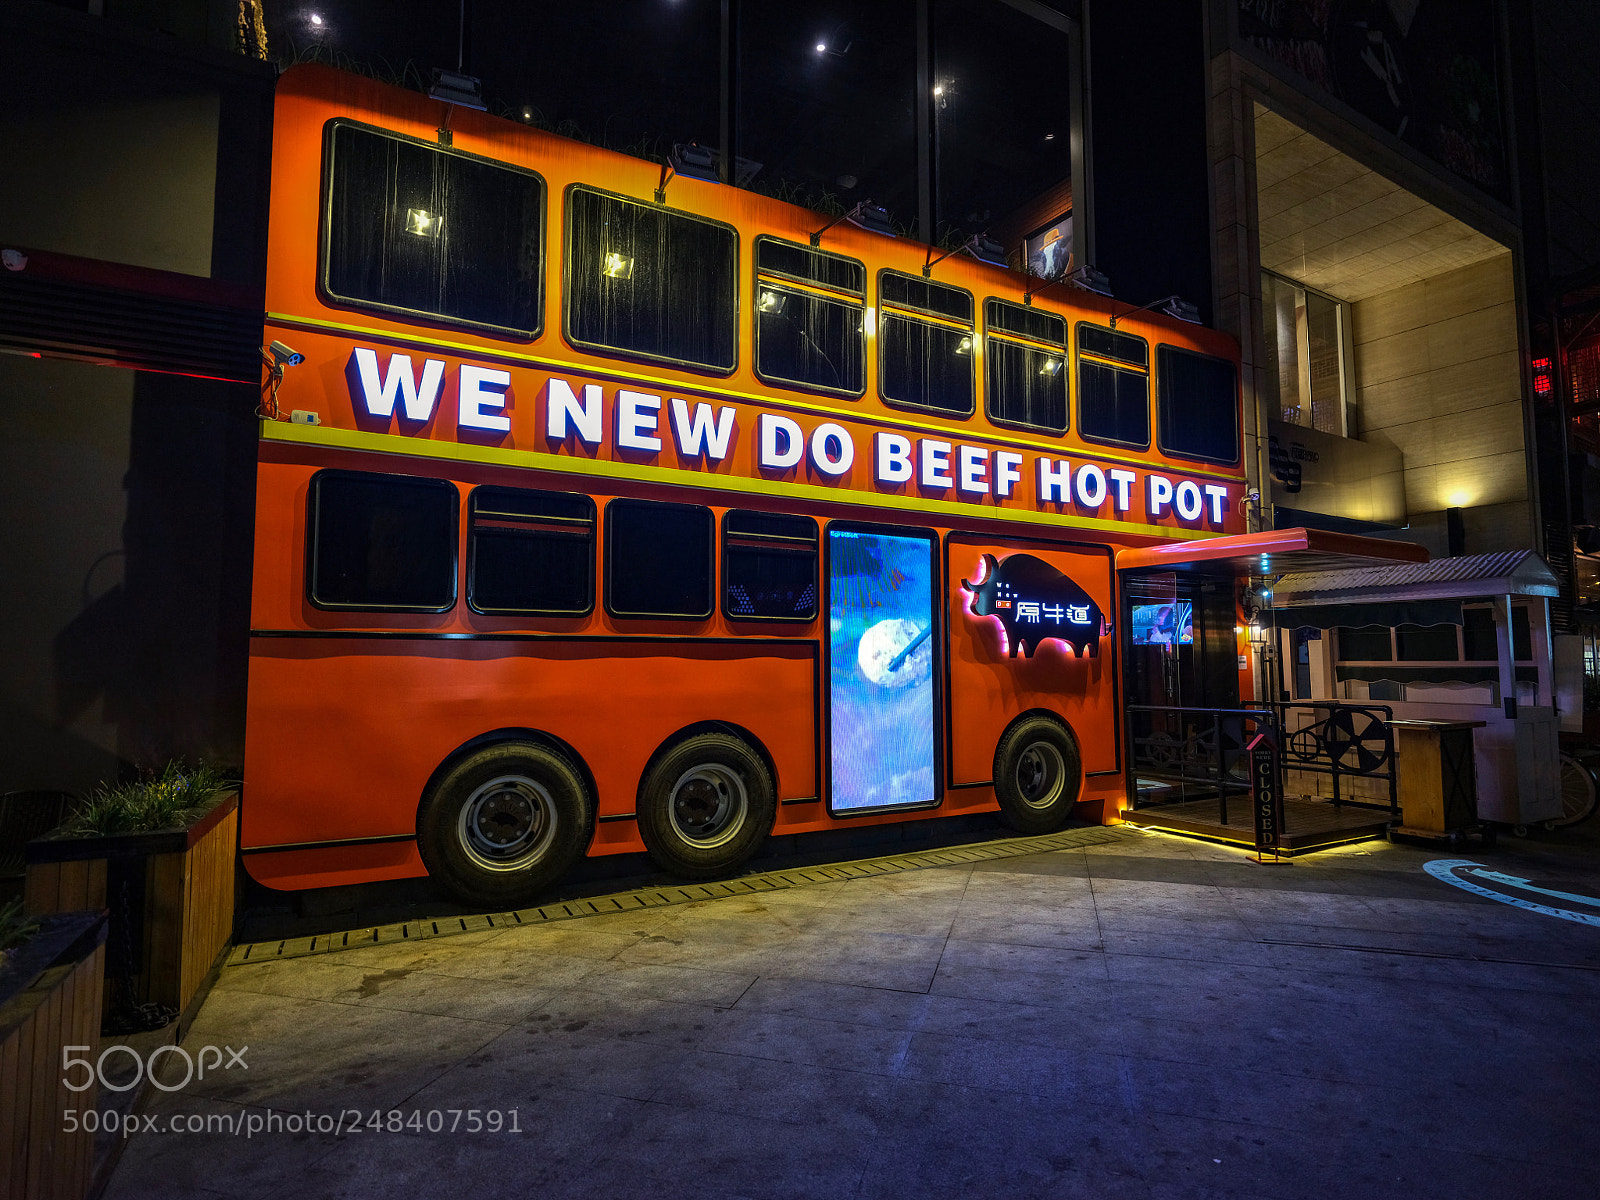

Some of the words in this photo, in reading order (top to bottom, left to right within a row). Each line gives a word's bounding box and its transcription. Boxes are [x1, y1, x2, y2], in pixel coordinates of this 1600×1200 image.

[352, 346, 512, 432] WE
[547, 377, 737, 460] NEW
[757, 412, 855, 476] DO
[873, 431, 1023, 496] BEEF
[1038, 456, 1136, 512] HOT
[1147, 474, 1228, 524] POT
[1015, 601, 1092, 625] 原牛道
[1259, 763, 1274, 843] CLOSED
